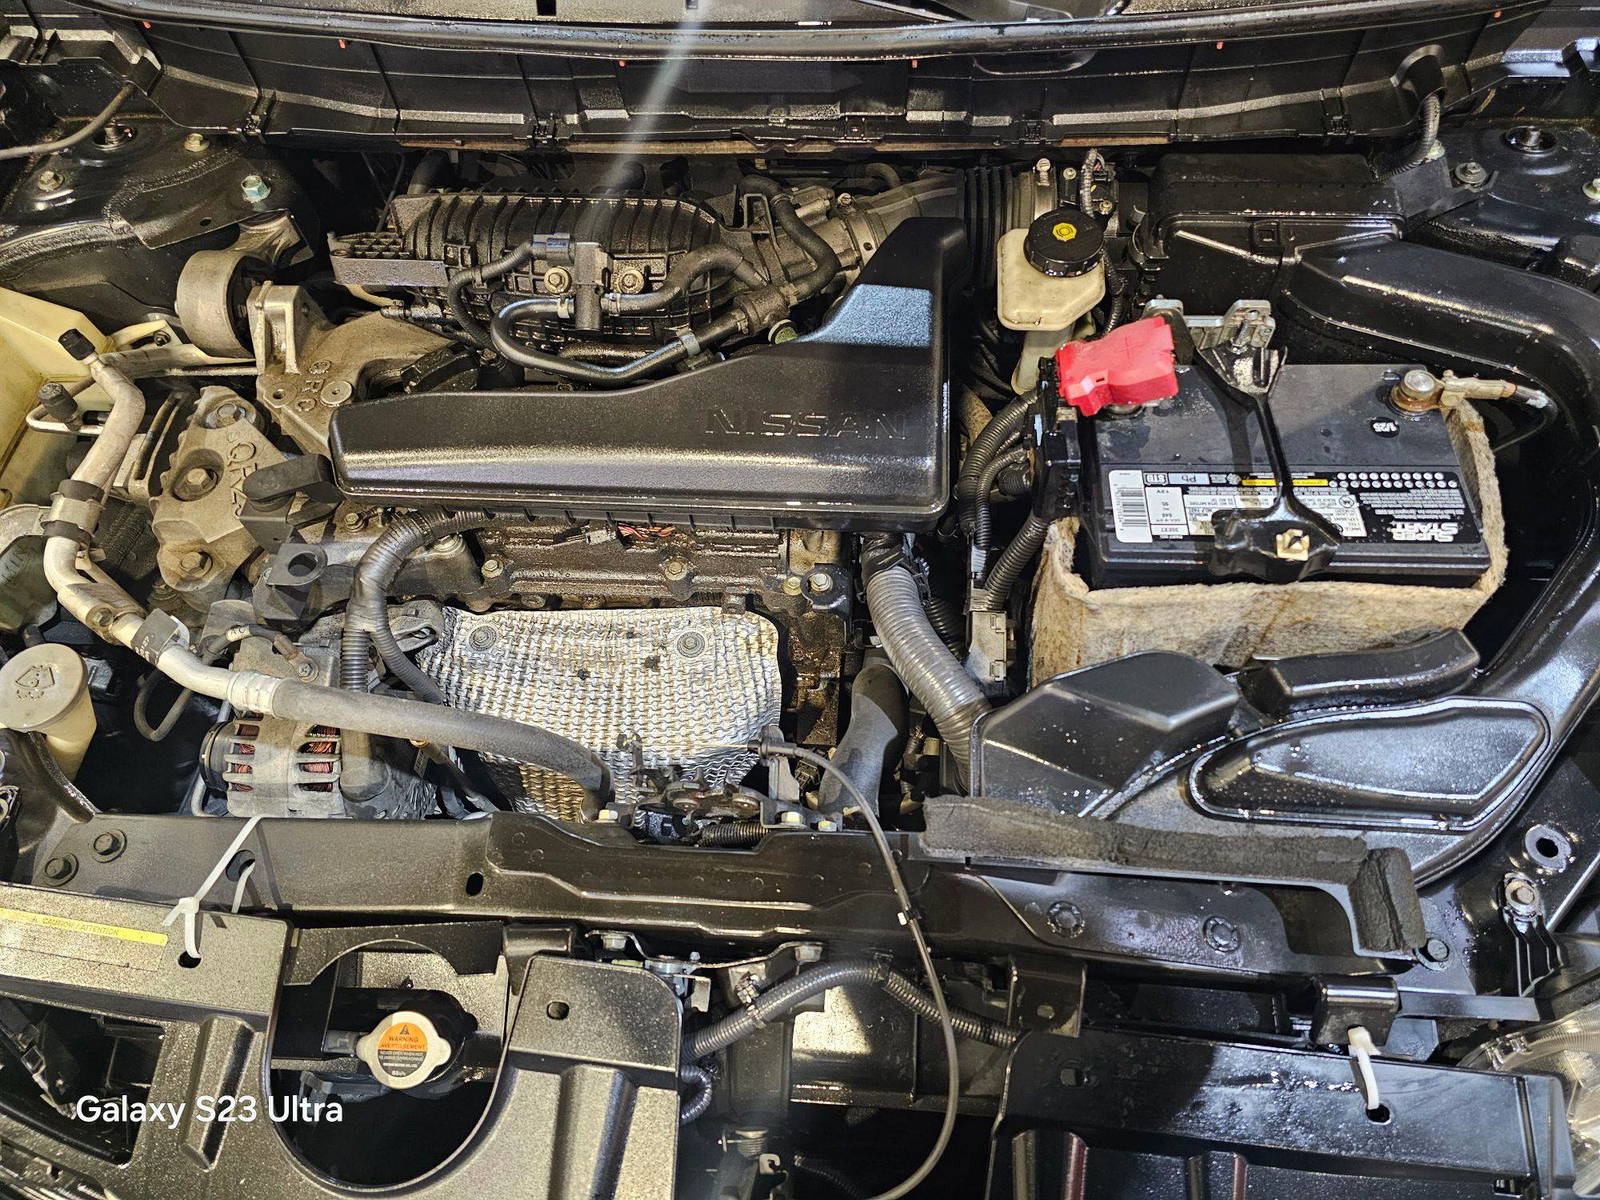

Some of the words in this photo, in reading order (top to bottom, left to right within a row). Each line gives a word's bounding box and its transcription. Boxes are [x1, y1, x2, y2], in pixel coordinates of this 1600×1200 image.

[704, 404, 907, 440] NISSAN
[1391, 521, 1459, 535] START
[1392, 531, 1454, 543] SUPER
